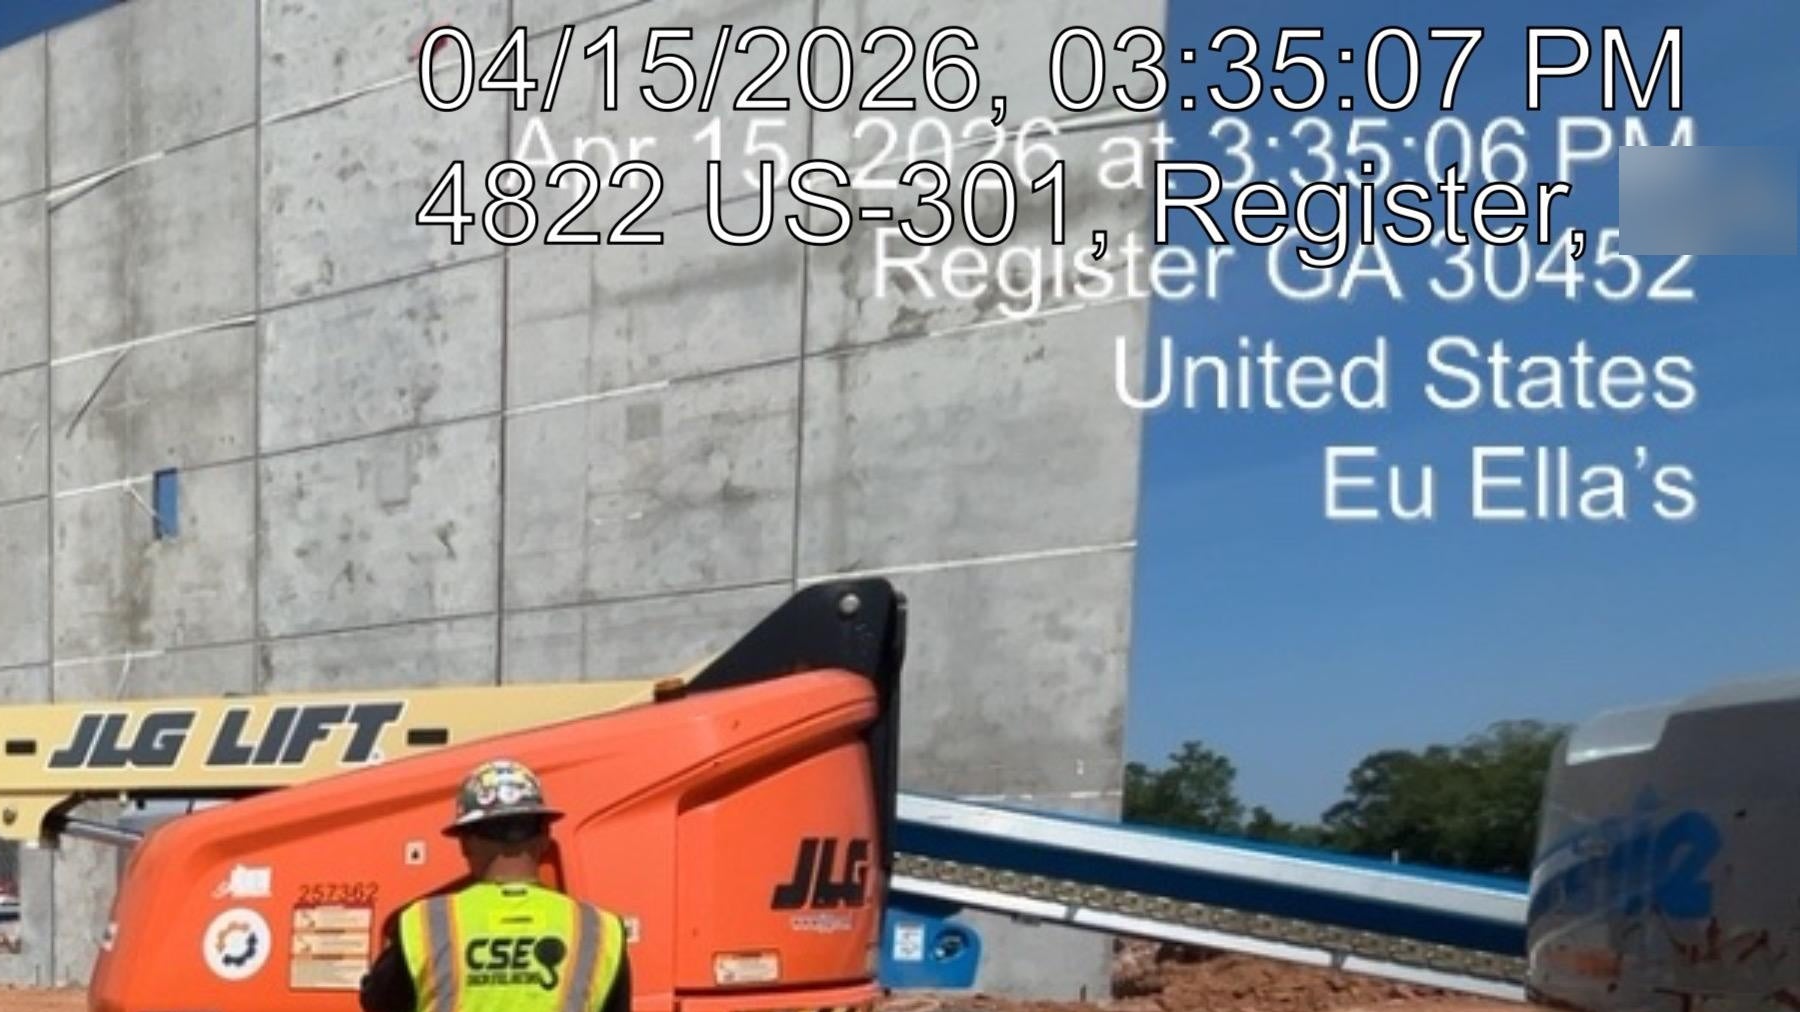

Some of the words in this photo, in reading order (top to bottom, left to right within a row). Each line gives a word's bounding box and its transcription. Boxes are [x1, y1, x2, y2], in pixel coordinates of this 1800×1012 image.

[47, 712, 196, 769] JLG
[206, 702, 404, 766] LIFT
[770, 836, 869, 910] JLG
[466, 938, 537, 970] CSE
